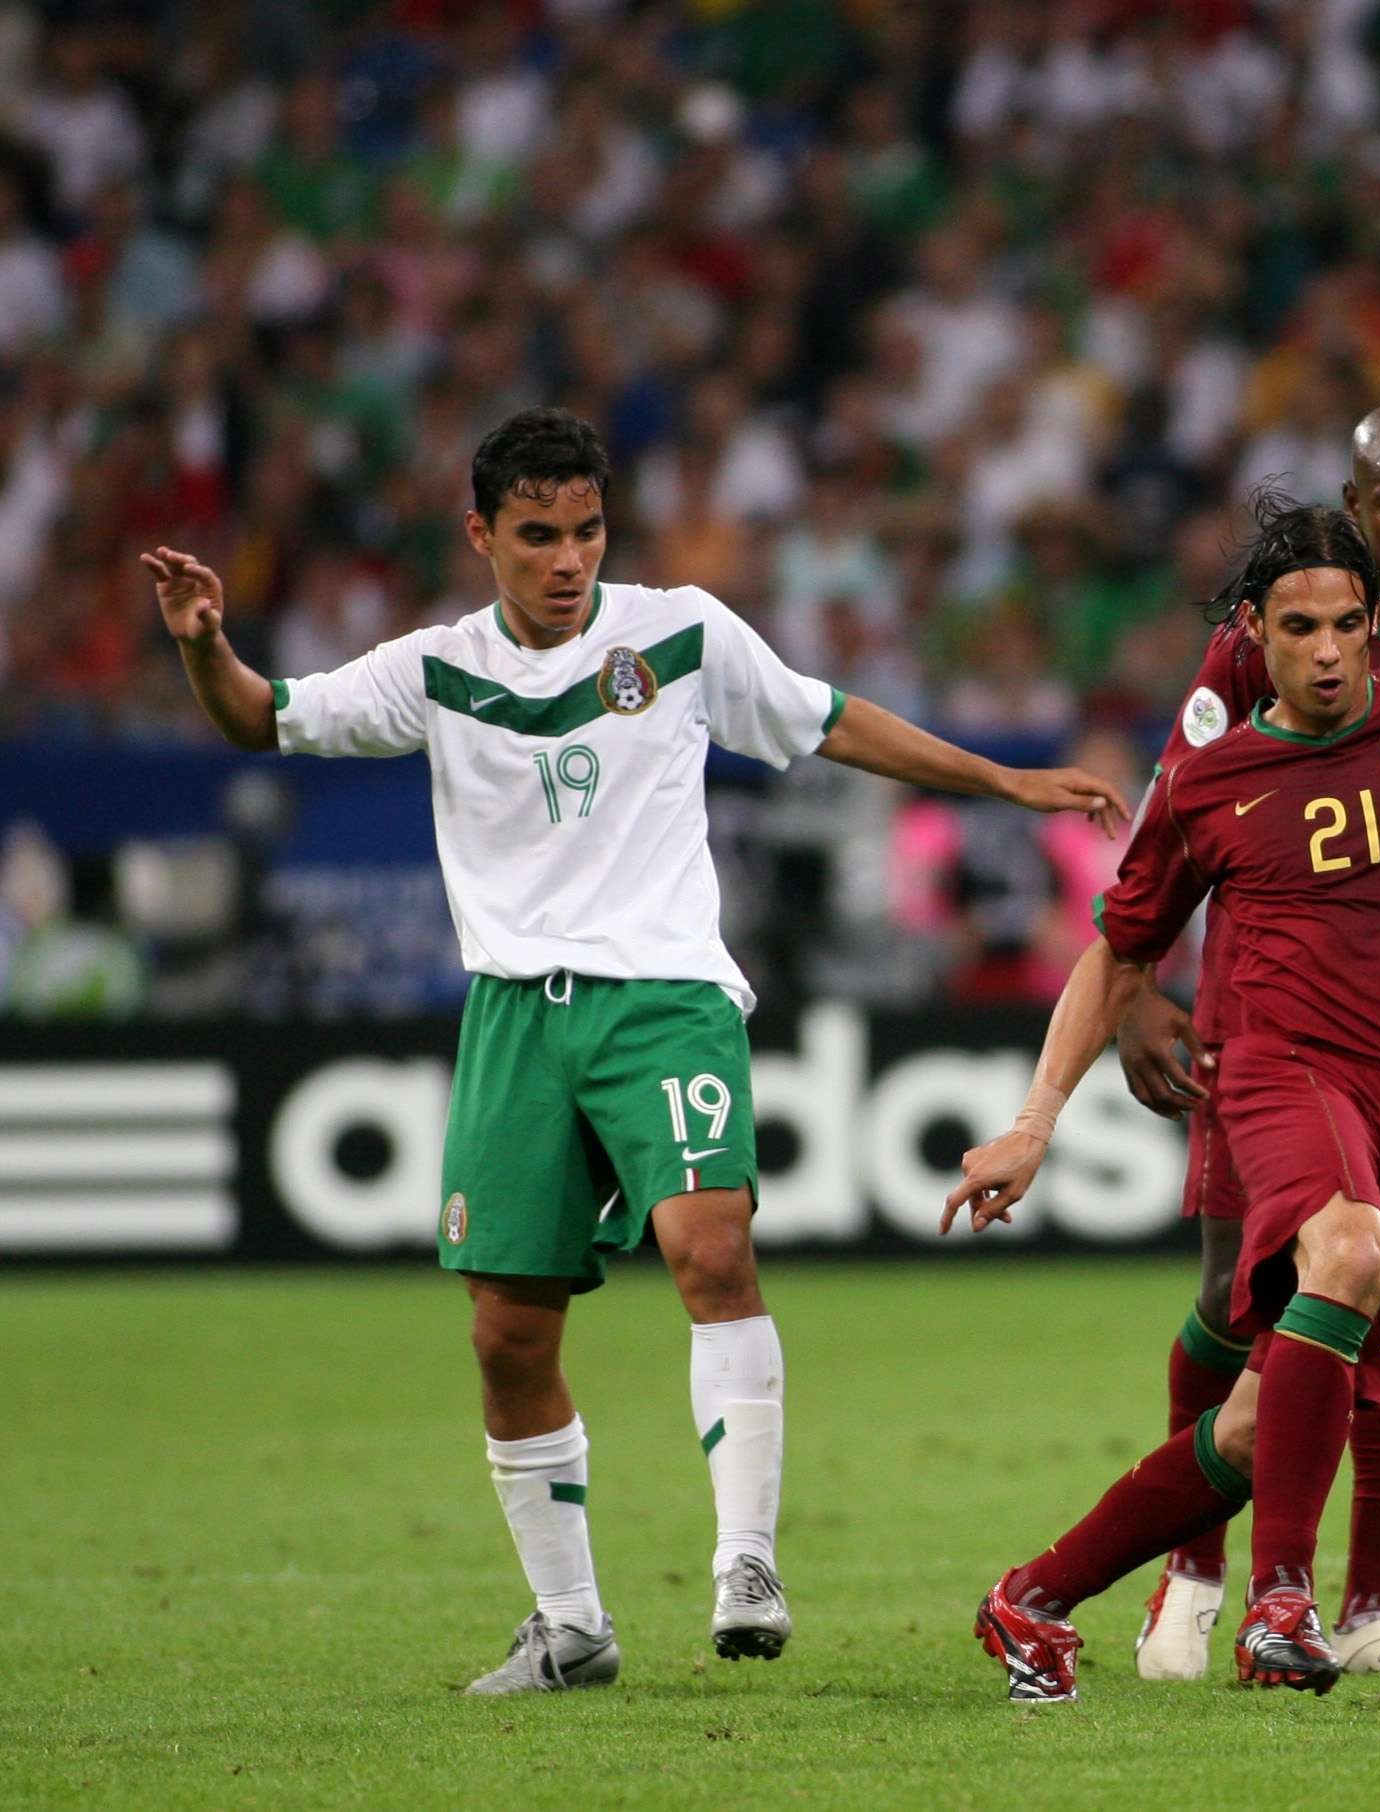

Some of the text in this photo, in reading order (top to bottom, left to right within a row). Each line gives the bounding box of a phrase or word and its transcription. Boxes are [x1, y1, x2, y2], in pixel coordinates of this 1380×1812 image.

[533, 744, 600, 824] 19
[1304, 789, 1380, 872] 21
[661, 1073, 732, 1142] 19
